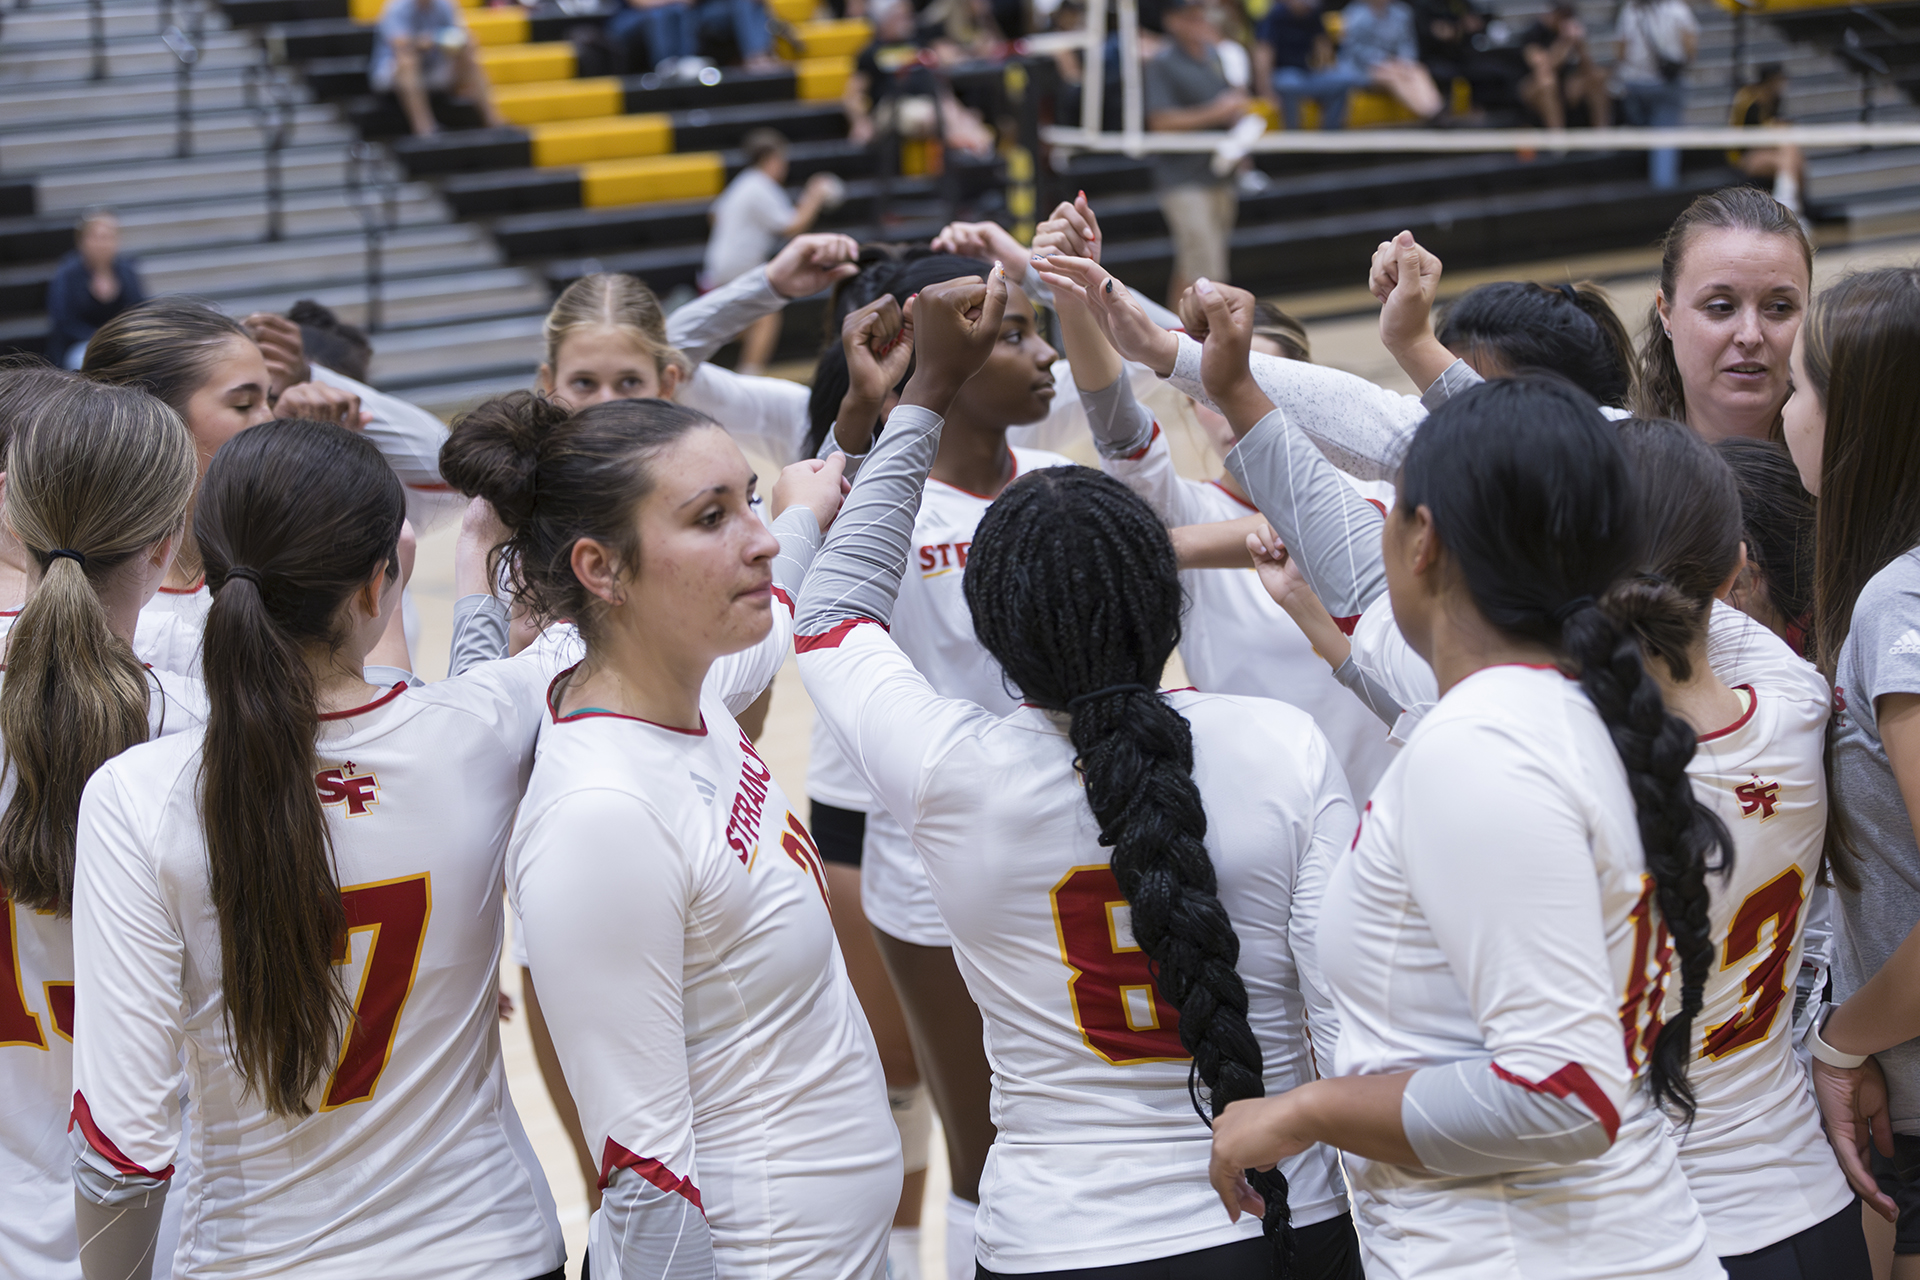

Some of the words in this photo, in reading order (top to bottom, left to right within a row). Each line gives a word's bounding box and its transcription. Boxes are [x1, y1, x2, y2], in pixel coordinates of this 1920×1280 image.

[313, 767, 381, 818] SF
[1732, 779, 1782, 823] SF
[318, 870, 432, 1113] 7
[1049, 863, 1198, 1067] 8
[1698, 863, 1805, 1063] 3
